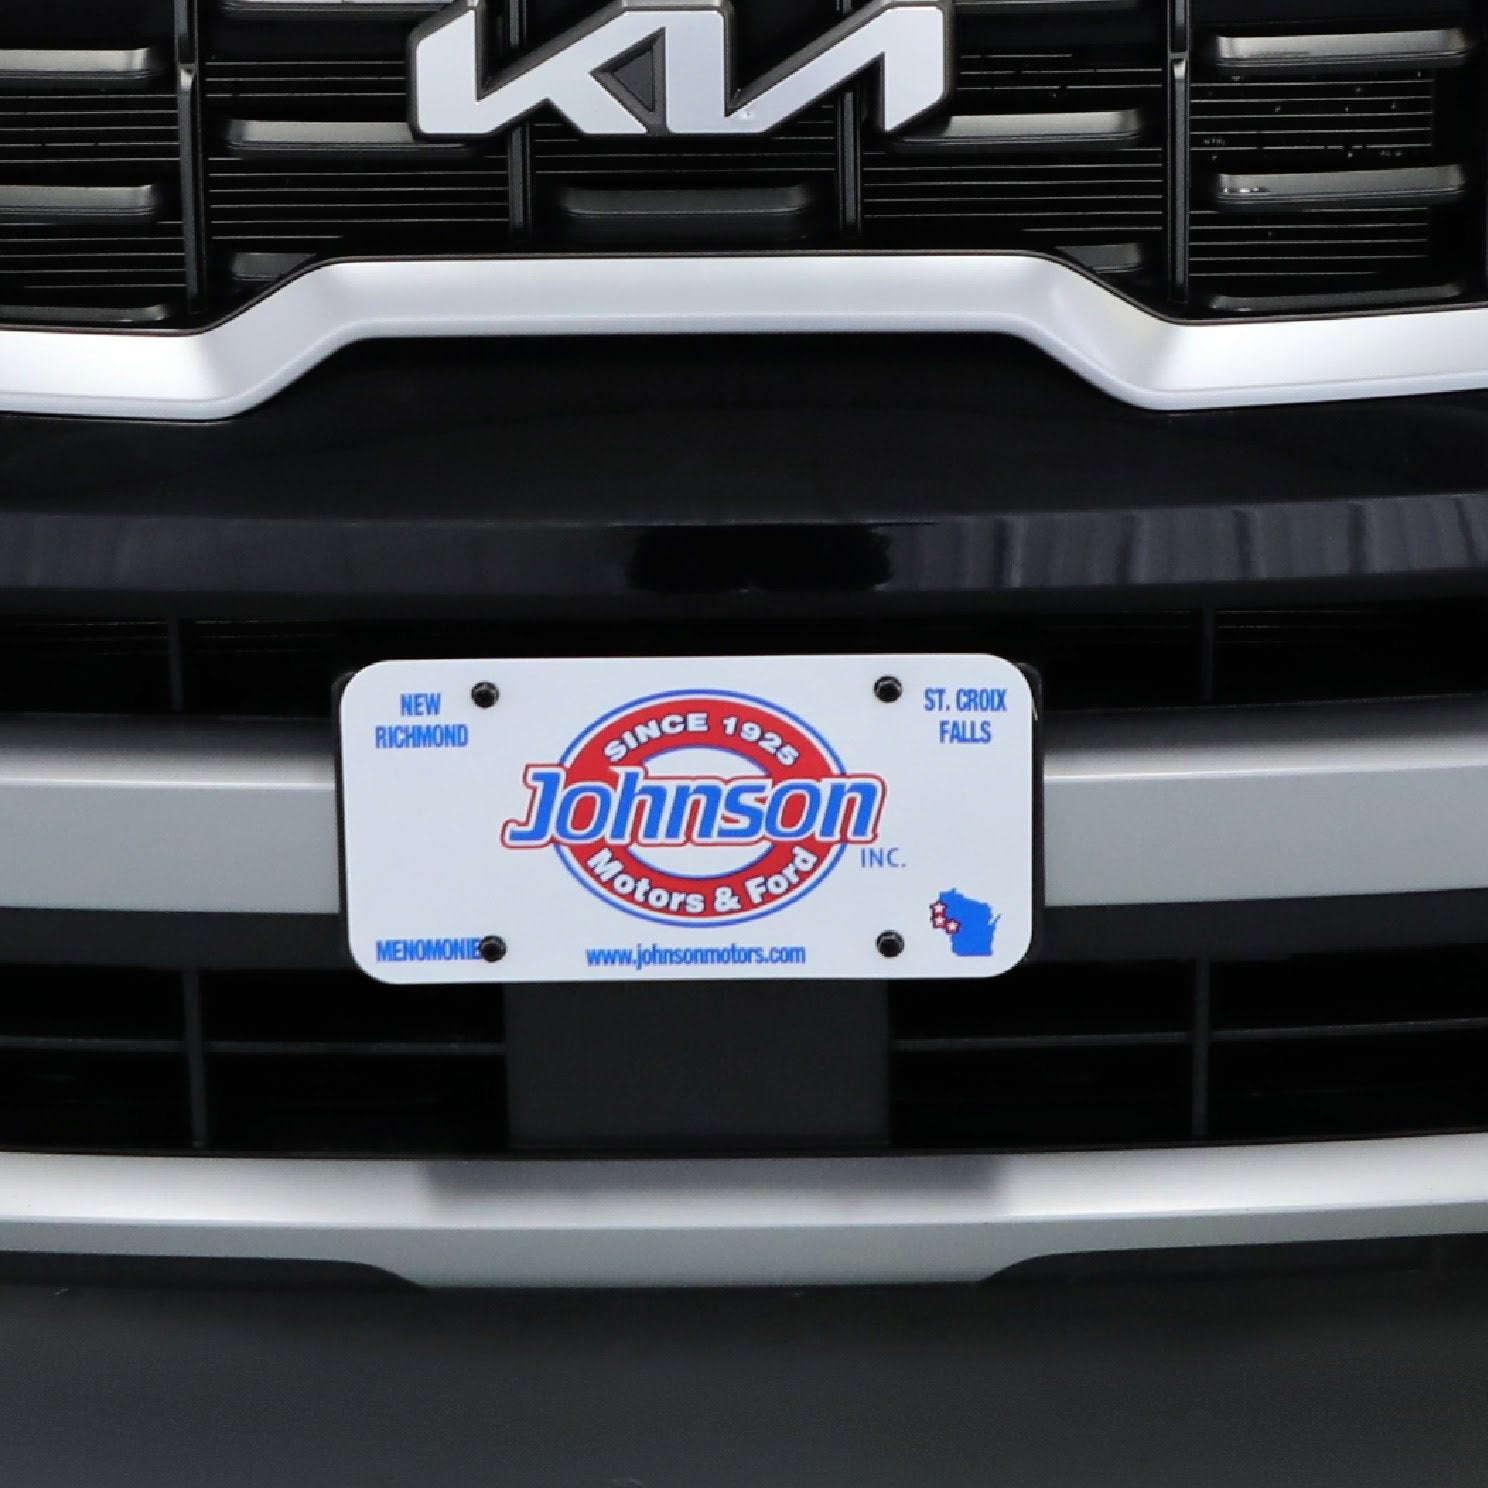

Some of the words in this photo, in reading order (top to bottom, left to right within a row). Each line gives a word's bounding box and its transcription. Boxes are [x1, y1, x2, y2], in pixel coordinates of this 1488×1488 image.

[398, 692, 444, 717] NEW
[924, 687, 950, 713] ST.
[954, 686, 1010, 713] CROIX
[372, 721, 470, 750] RICHMOND
[603, 712, 708, 764] SINCE
[722, 716, 801, 766] 1925
[938, 718, 994, 745] FALLS
[506, 768, 880, 844] Johnson
[859, 847, 907, 868] INC.
[585, 846, 706, 913] Motors
[713, 885, 742, 913] &
[743, 845, 819, 905] Ford
[374, 936, 483, 964] MENOMONIE
[585, 944, 808, 971] www.johnsonmotors.com
